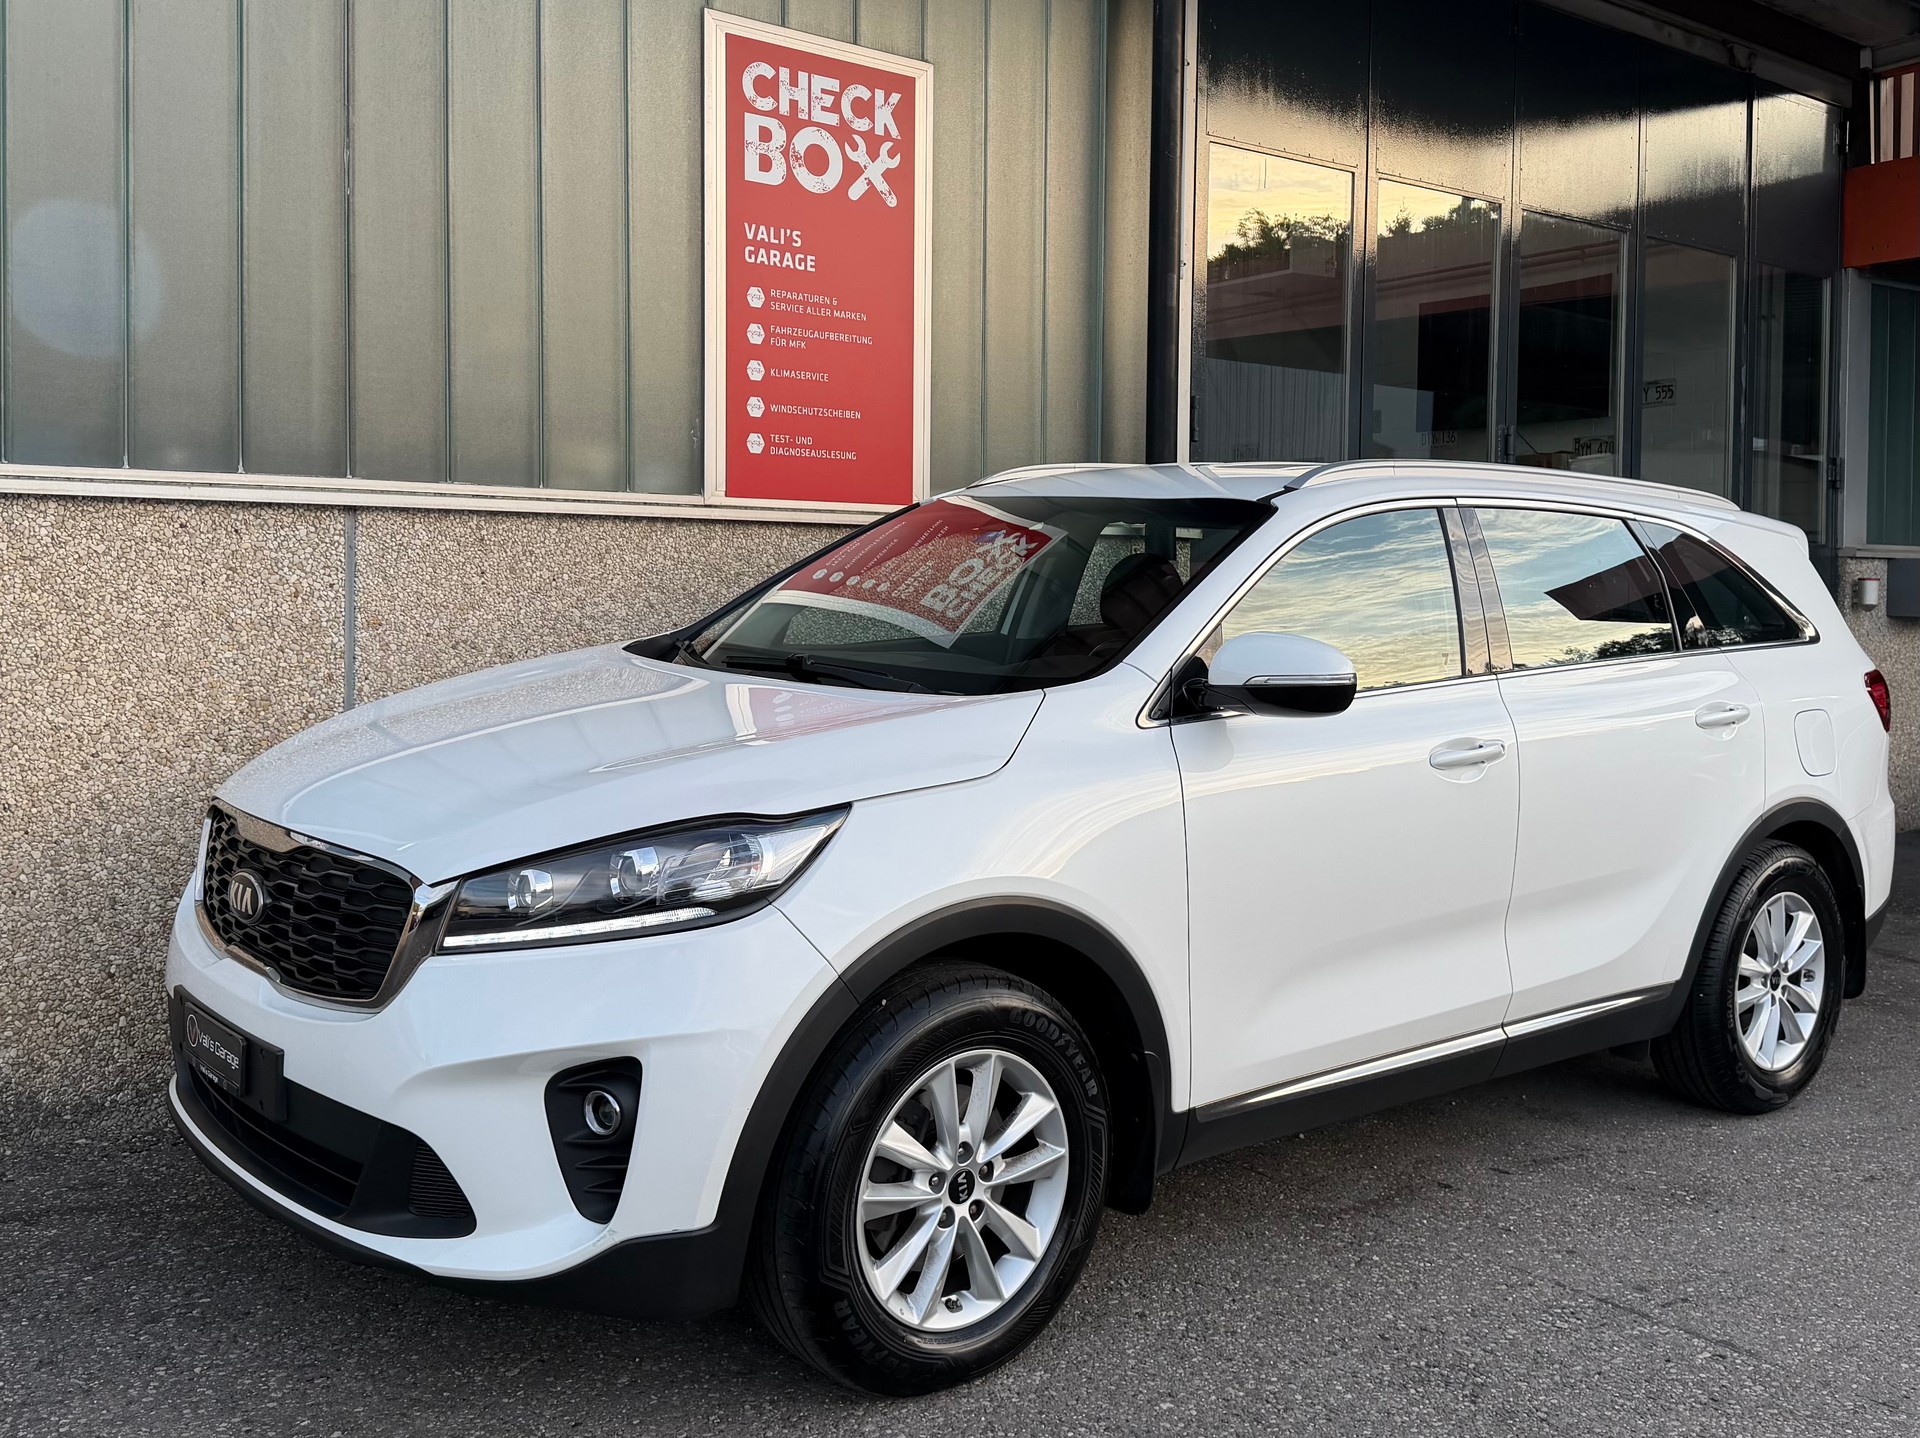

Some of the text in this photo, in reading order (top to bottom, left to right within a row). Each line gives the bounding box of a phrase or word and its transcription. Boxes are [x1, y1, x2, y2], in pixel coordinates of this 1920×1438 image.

[742, 61, 902, 140] CHECK
[744, 112, 901, 208] BOX
[744, 222, 802, 247] VALI'S
[744, 246, 816, 272] GARAGE
[770, 288, 838, 306] REPARATUREN &
[770, 301, 867, 321] SERVICE ALLER MARKEN
[770, 325, 873, 345] FAHRZEUGAUFBEREITUNG
[770, 336, 807, 349] FÜR MFK
[770, 367, 829, 382] KLIMASERVICE
[1655, 384, 1674, 401] 555
[770, 403, 861, 420] WINDSCHUTZSCHEIBEN
[770, 434, 813, 445] TEST- UND
[770, 446, 857, 461] DIAGNOSEAUSLESUNG
[230, 879, 253, 916] KIA
[214, 1041, 240, 1070] Garage
[1009, 1007, 1098, 1098] GOODYEAR
[957, 1171, 969, 1202] KIA
